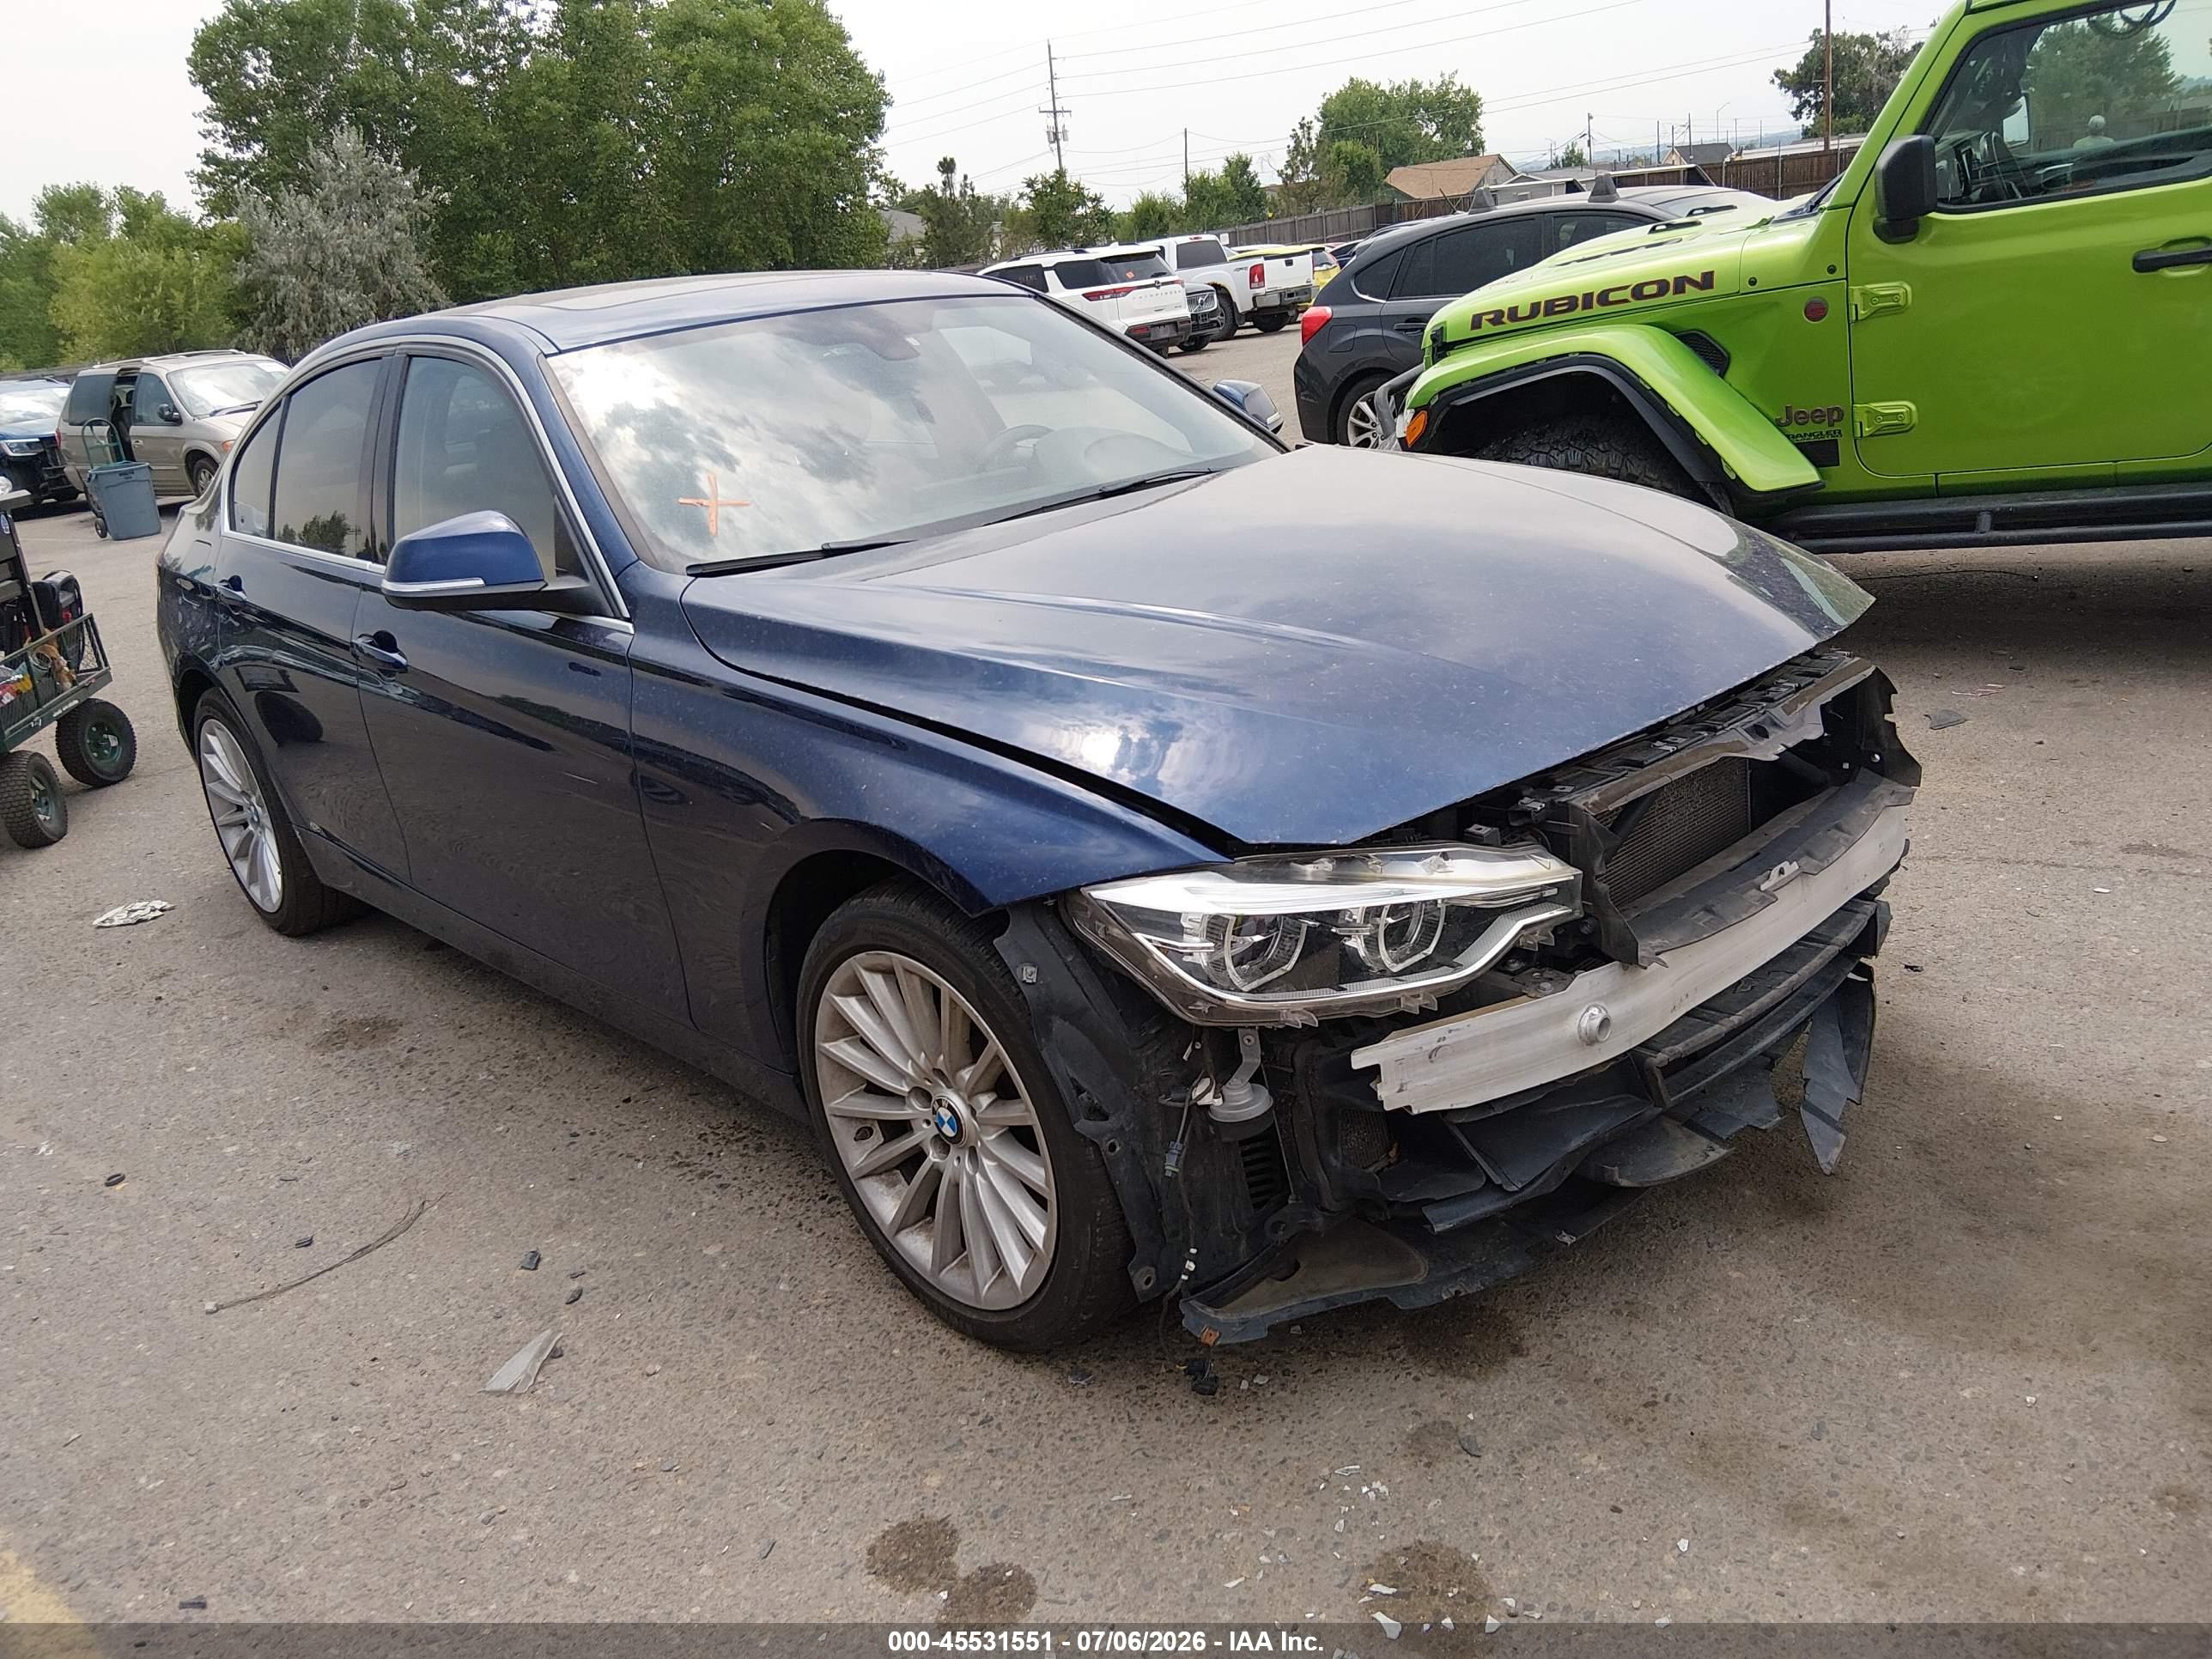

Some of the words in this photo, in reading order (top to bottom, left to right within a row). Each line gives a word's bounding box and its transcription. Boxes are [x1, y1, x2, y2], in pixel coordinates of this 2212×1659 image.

[1469, 270, 1716, 331] RUBICON
[1775, 404, 1844, 428] Jeep
[1787, 428, 1842, 440] RANGLER
